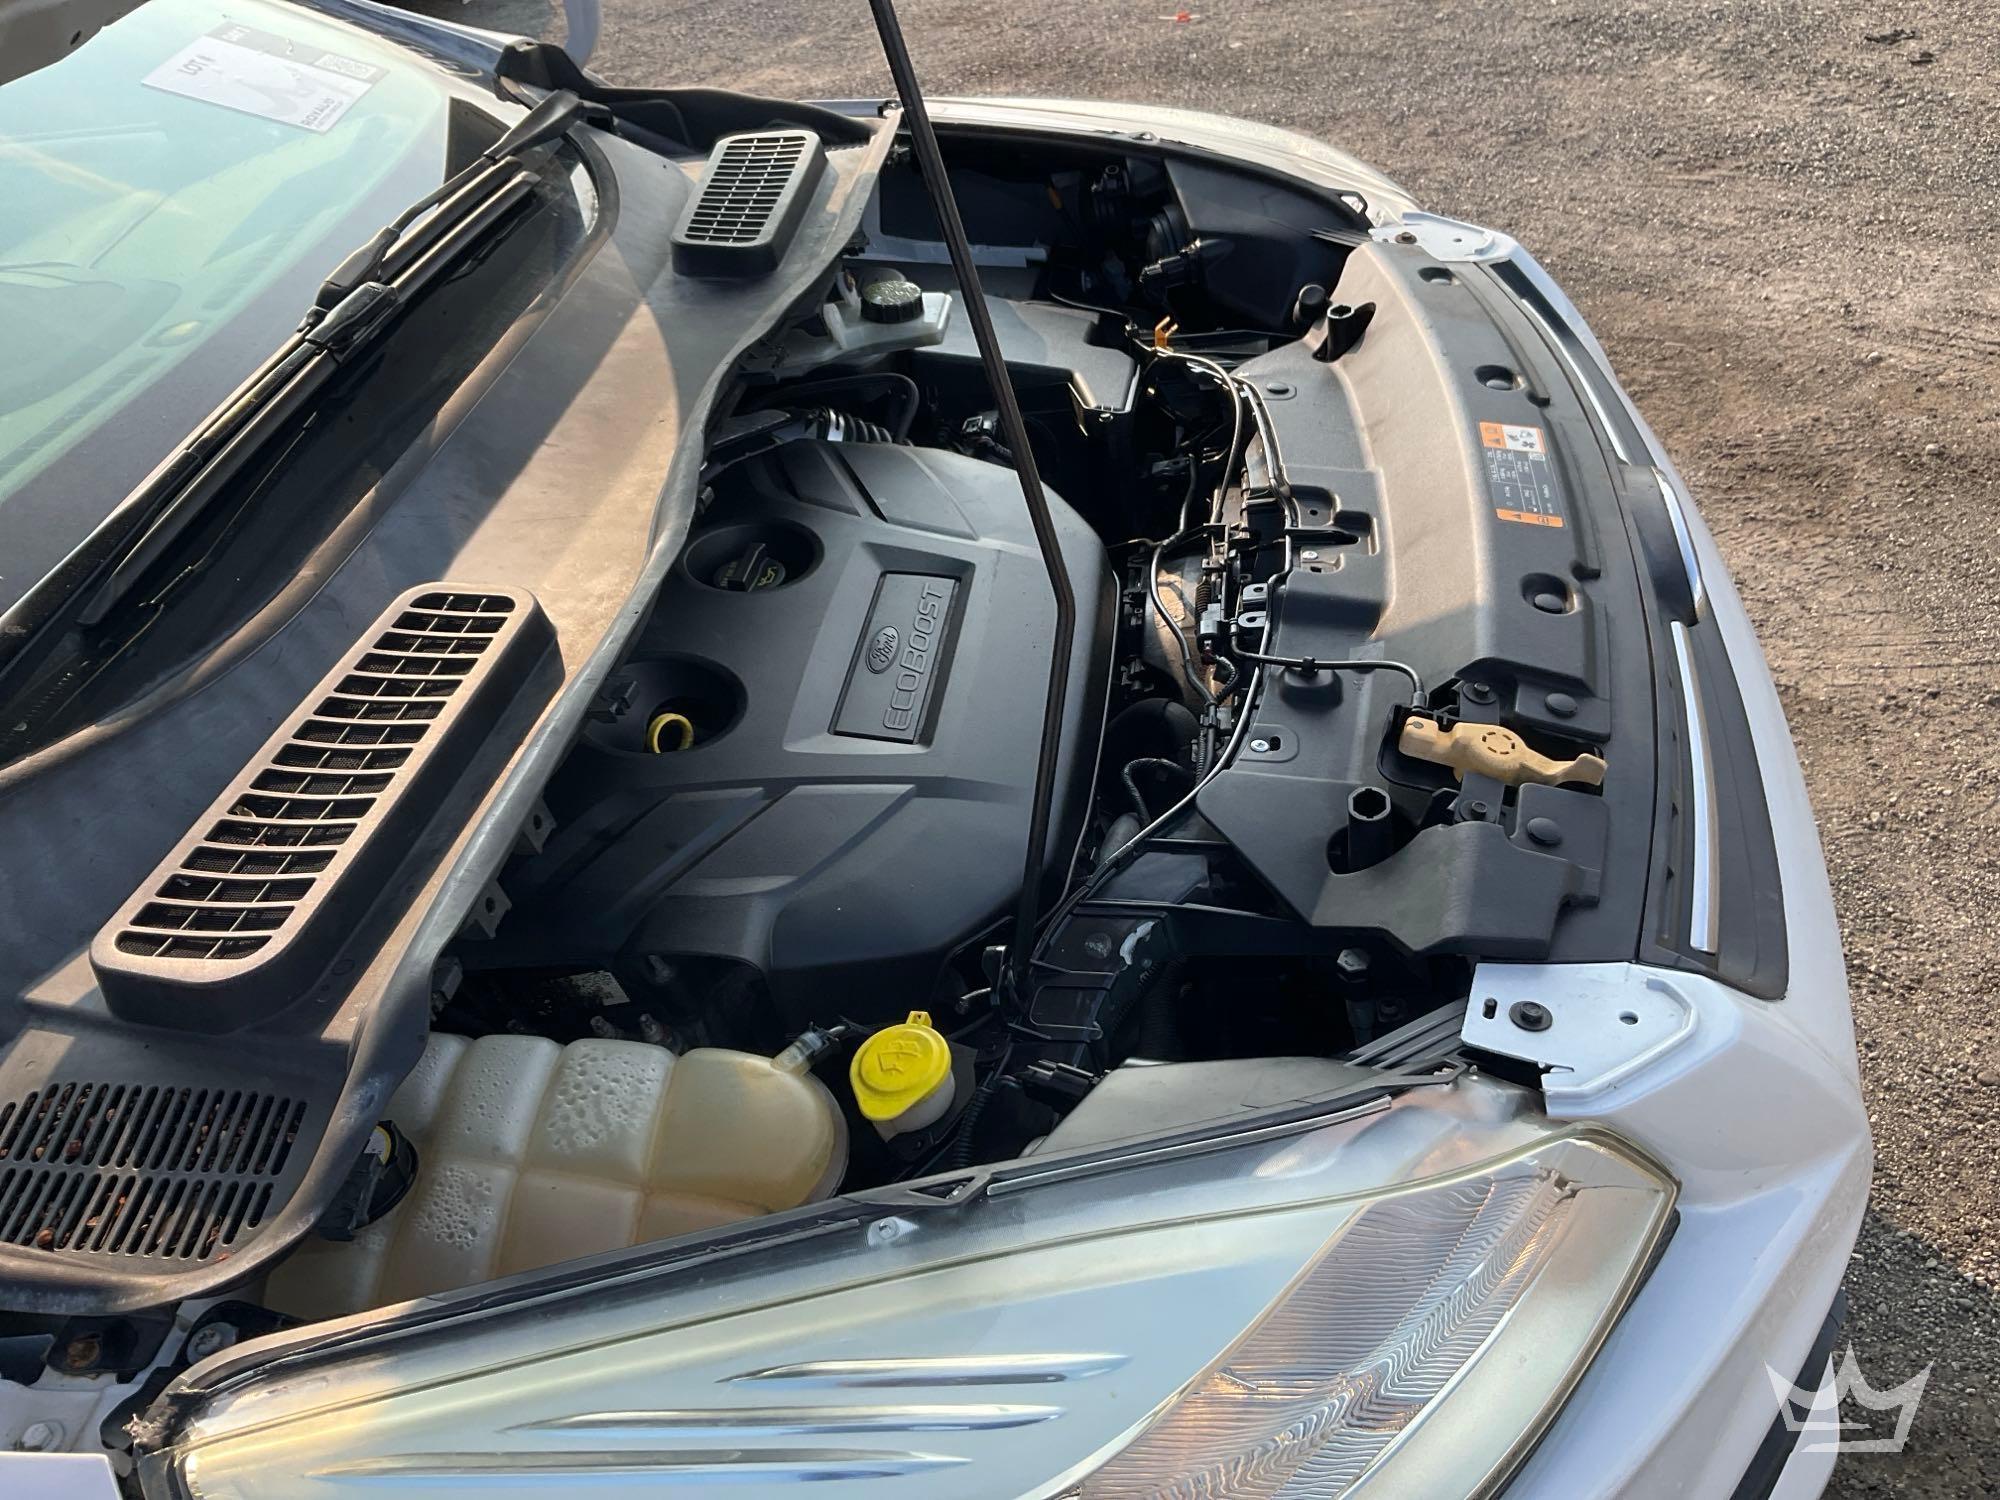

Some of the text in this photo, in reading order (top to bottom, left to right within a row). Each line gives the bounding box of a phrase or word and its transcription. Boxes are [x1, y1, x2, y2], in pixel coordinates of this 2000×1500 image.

[176, 59, 208, 76] LOT
[871, 631, 896, 664] Ford
[883, 582, 943, 731] ECOBOOST
